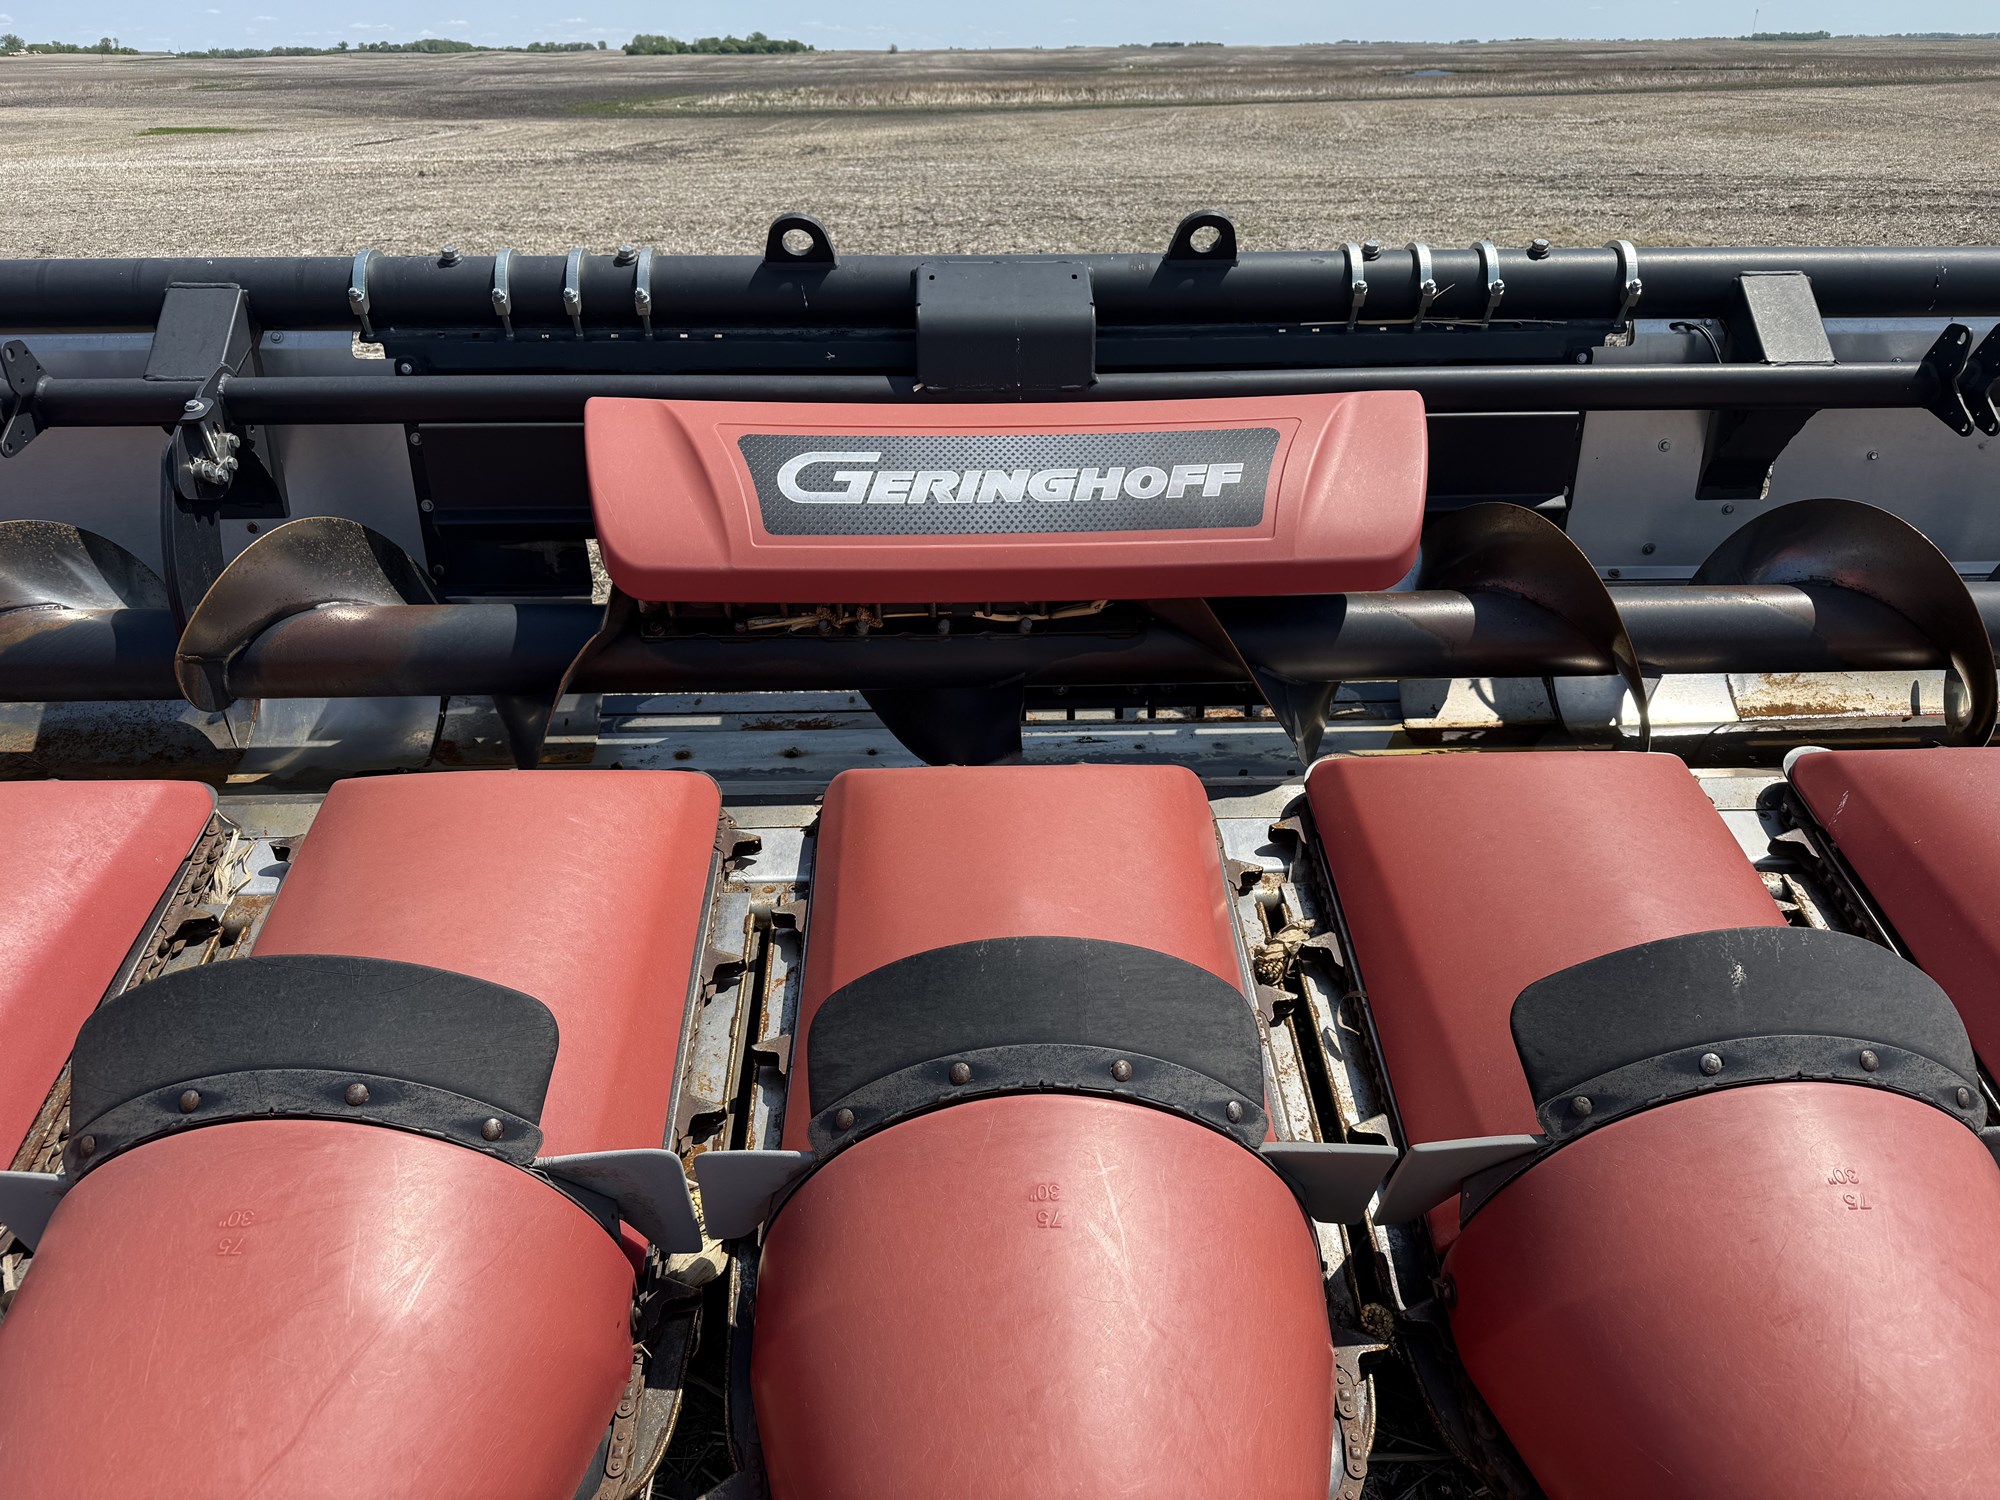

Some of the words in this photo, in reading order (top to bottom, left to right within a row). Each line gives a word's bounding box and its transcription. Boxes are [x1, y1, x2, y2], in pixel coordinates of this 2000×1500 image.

[777, 451, 1245, 505] GERINGHOFF
[1842, 1192, 1873, 1211] 75
[1036, 1210, 1062, 1229] 75
[217, 1237, 244, 1256] 75
